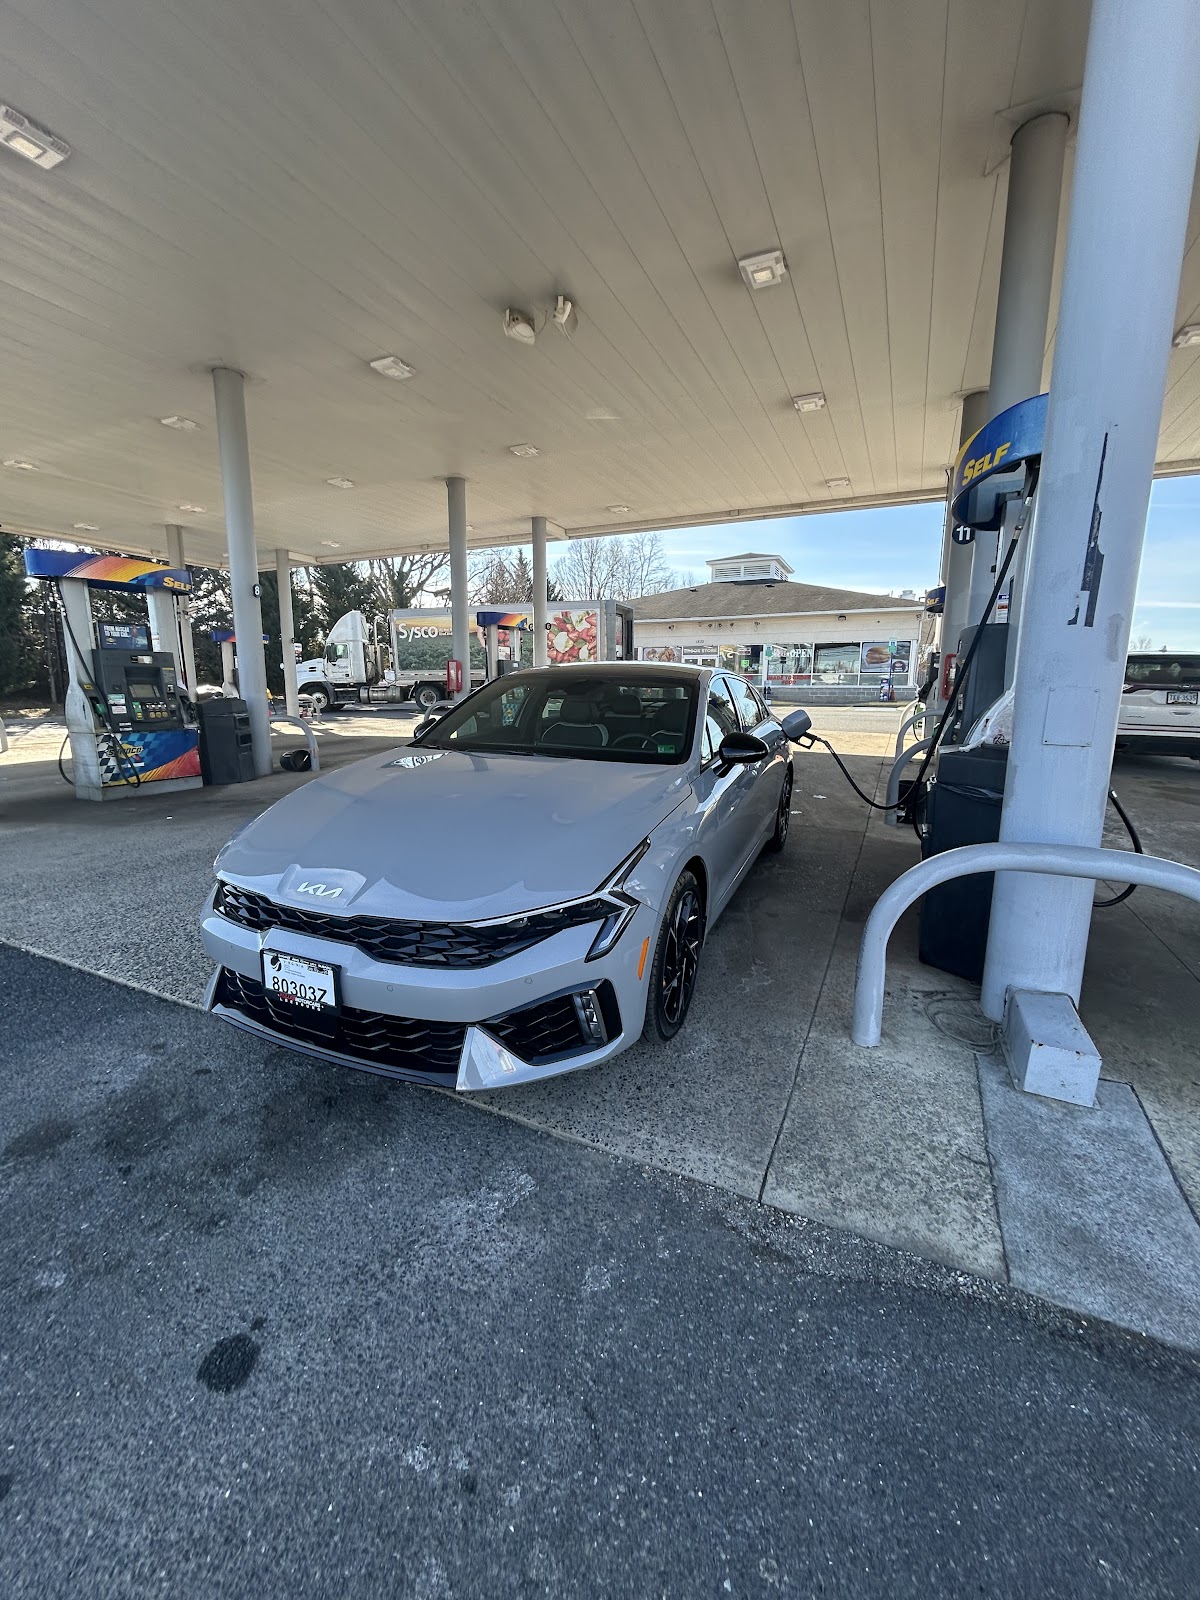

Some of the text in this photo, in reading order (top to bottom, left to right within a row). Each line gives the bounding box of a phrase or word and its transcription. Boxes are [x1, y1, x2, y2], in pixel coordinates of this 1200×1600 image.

[962, 442, 1011, 486] SELF
[956, 525, 971, 541] 11
[163, 577, 191, 592] SELF
[255, 585, 260, 594] 8
[790, 649, 812, 658] OPEN
